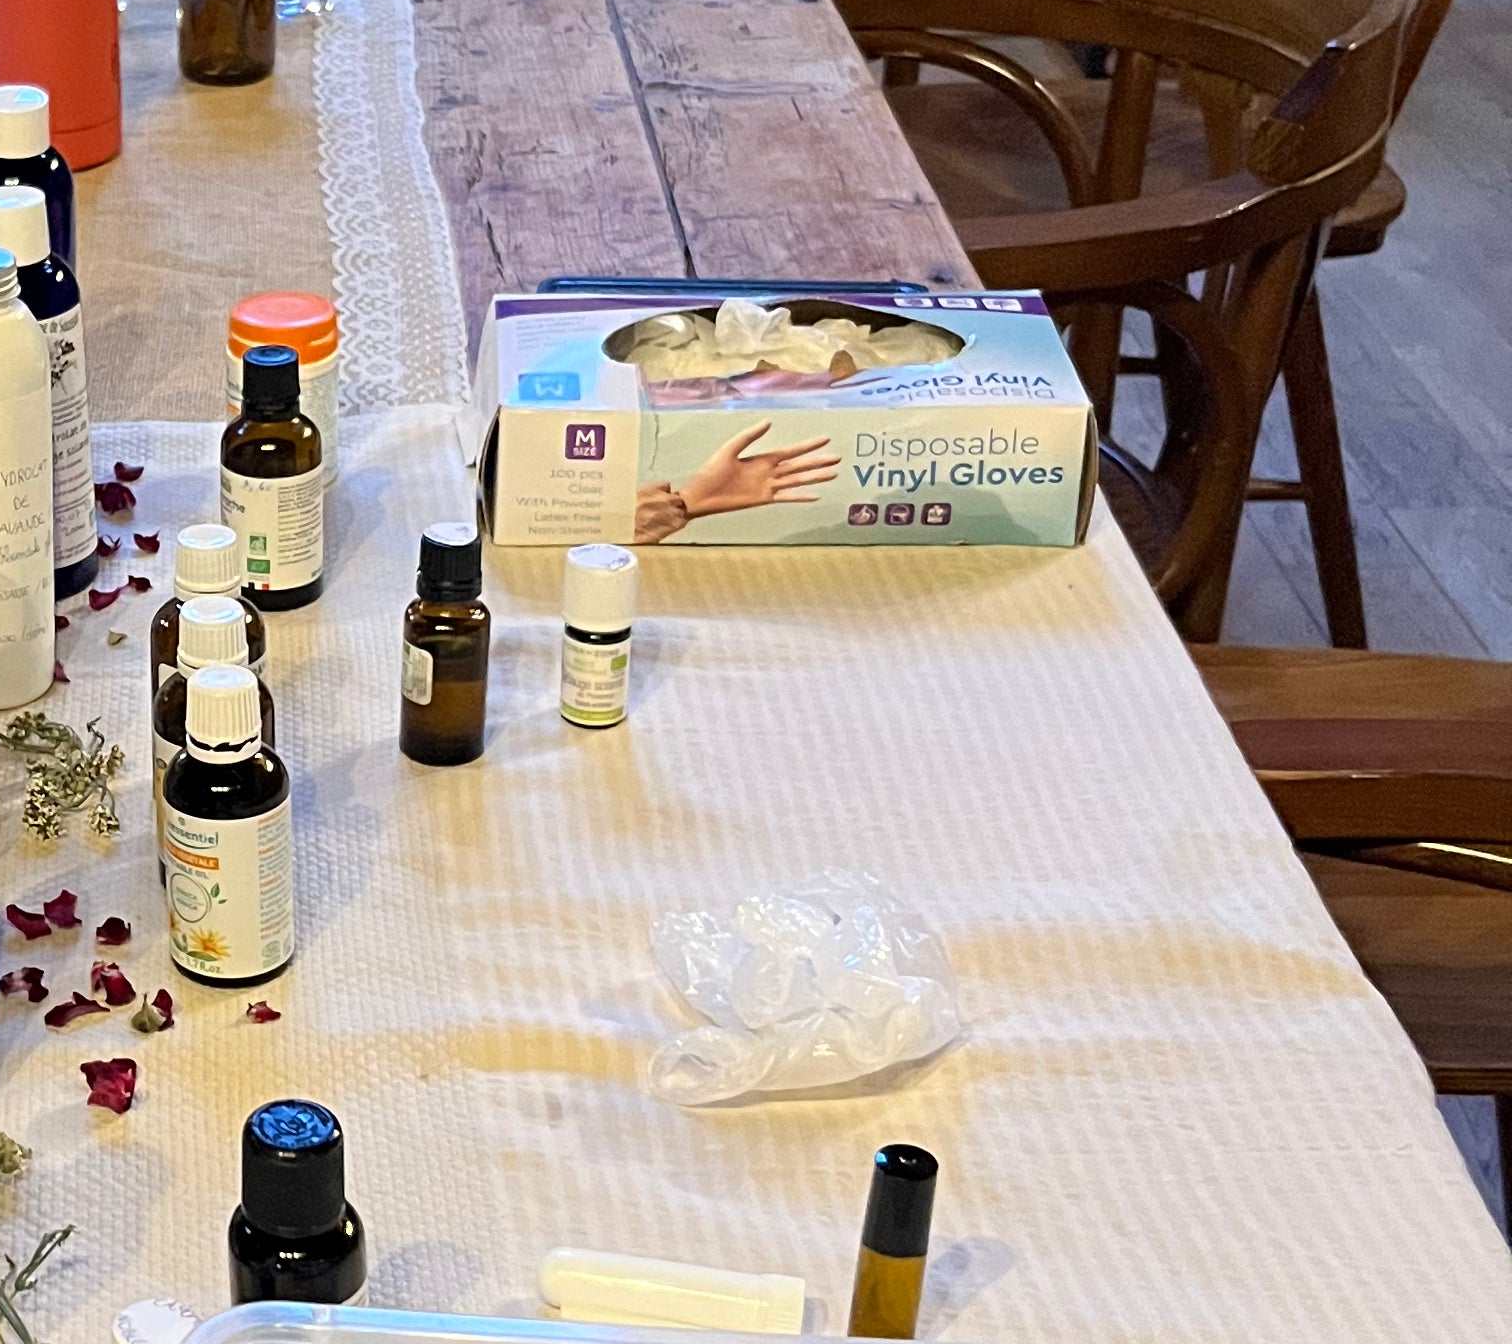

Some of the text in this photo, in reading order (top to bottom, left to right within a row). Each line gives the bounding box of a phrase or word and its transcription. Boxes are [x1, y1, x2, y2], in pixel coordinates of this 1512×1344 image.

[575, 429, 595, 446] M
[856, 428, 1039, 461] Disposable
[573, 447, 597, 456] SIZE
[550, 470, 574, 479] 100
[853, 460, 1064, 493] Vinyl Gloves
[568, 484, 602, 494] Clear
[13, 494, 29, 510] DE
